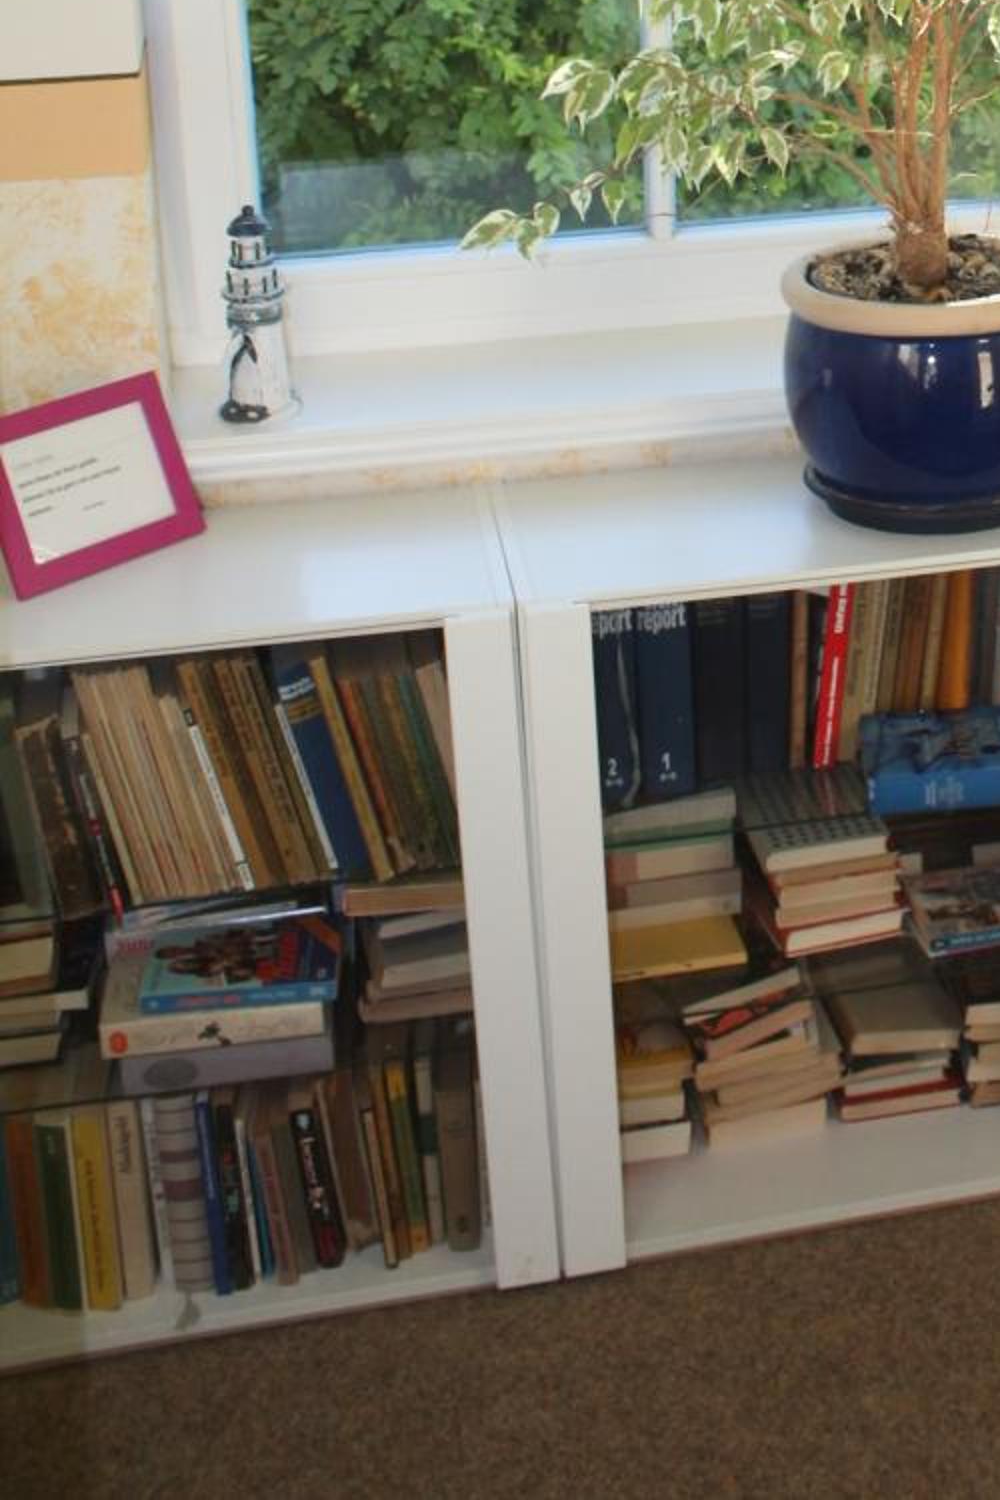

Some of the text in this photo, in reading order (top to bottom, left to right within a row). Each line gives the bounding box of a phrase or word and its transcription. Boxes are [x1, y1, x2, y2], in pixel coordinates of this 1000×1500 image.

[637, 604, 686, 634] report
[607, 757, 619, 777] 2
[661, 752, 672, 771] 1
